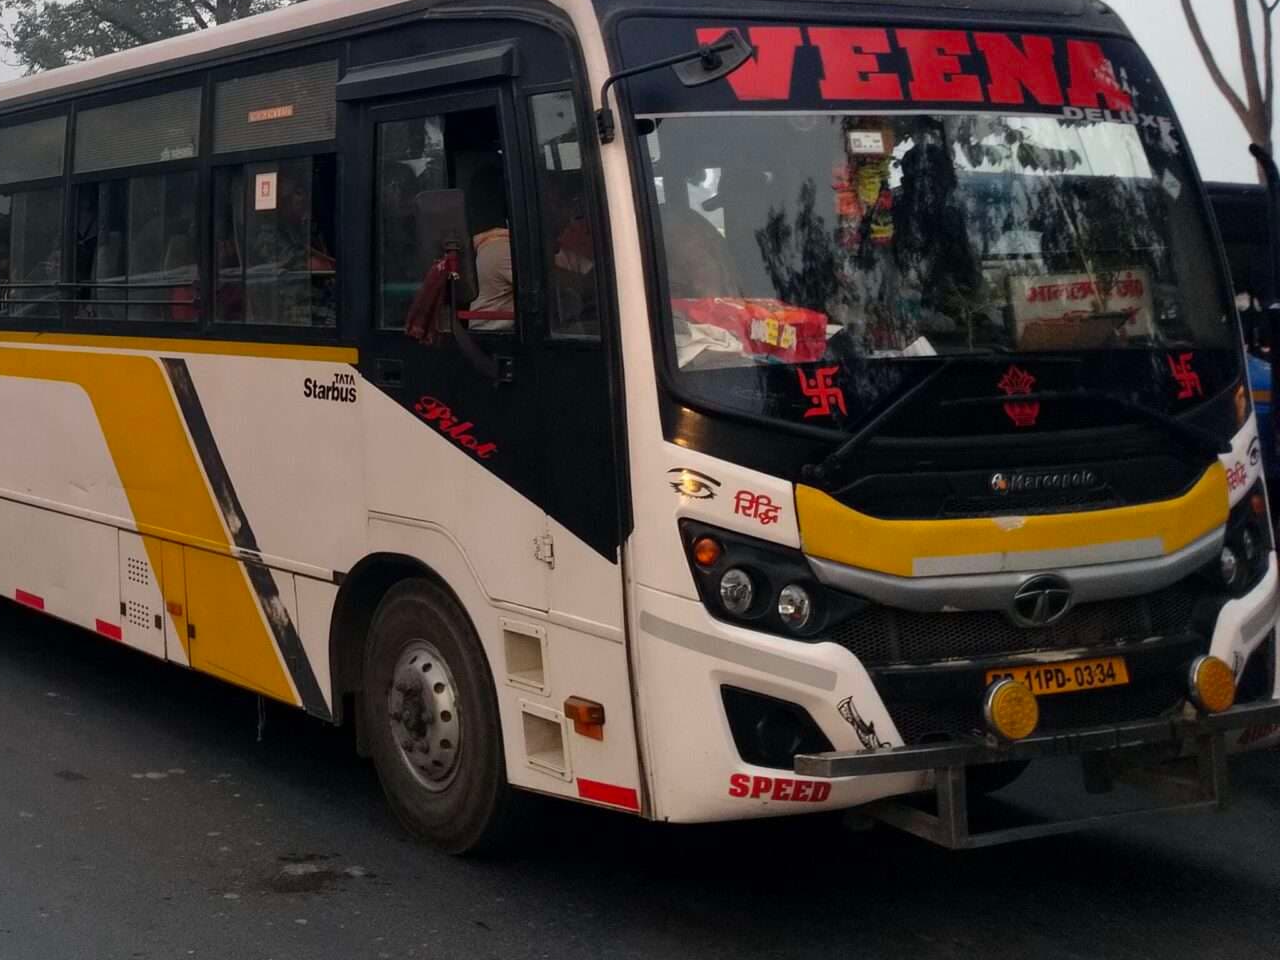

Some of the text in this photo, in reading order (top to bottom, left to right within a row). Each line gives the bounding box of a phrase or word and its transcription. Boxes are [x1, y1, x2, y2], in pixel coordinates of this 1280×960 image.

[695, 27, 1133, 111] VEENA
[304, 377, 357, 404] Starbus
[334, 373, 356, 386] TATA
[415, 395, 497, 459] Pilot
[1010, 470, 1095, 490] Marcopolo
[728, 773, 832, 803] SPEED
